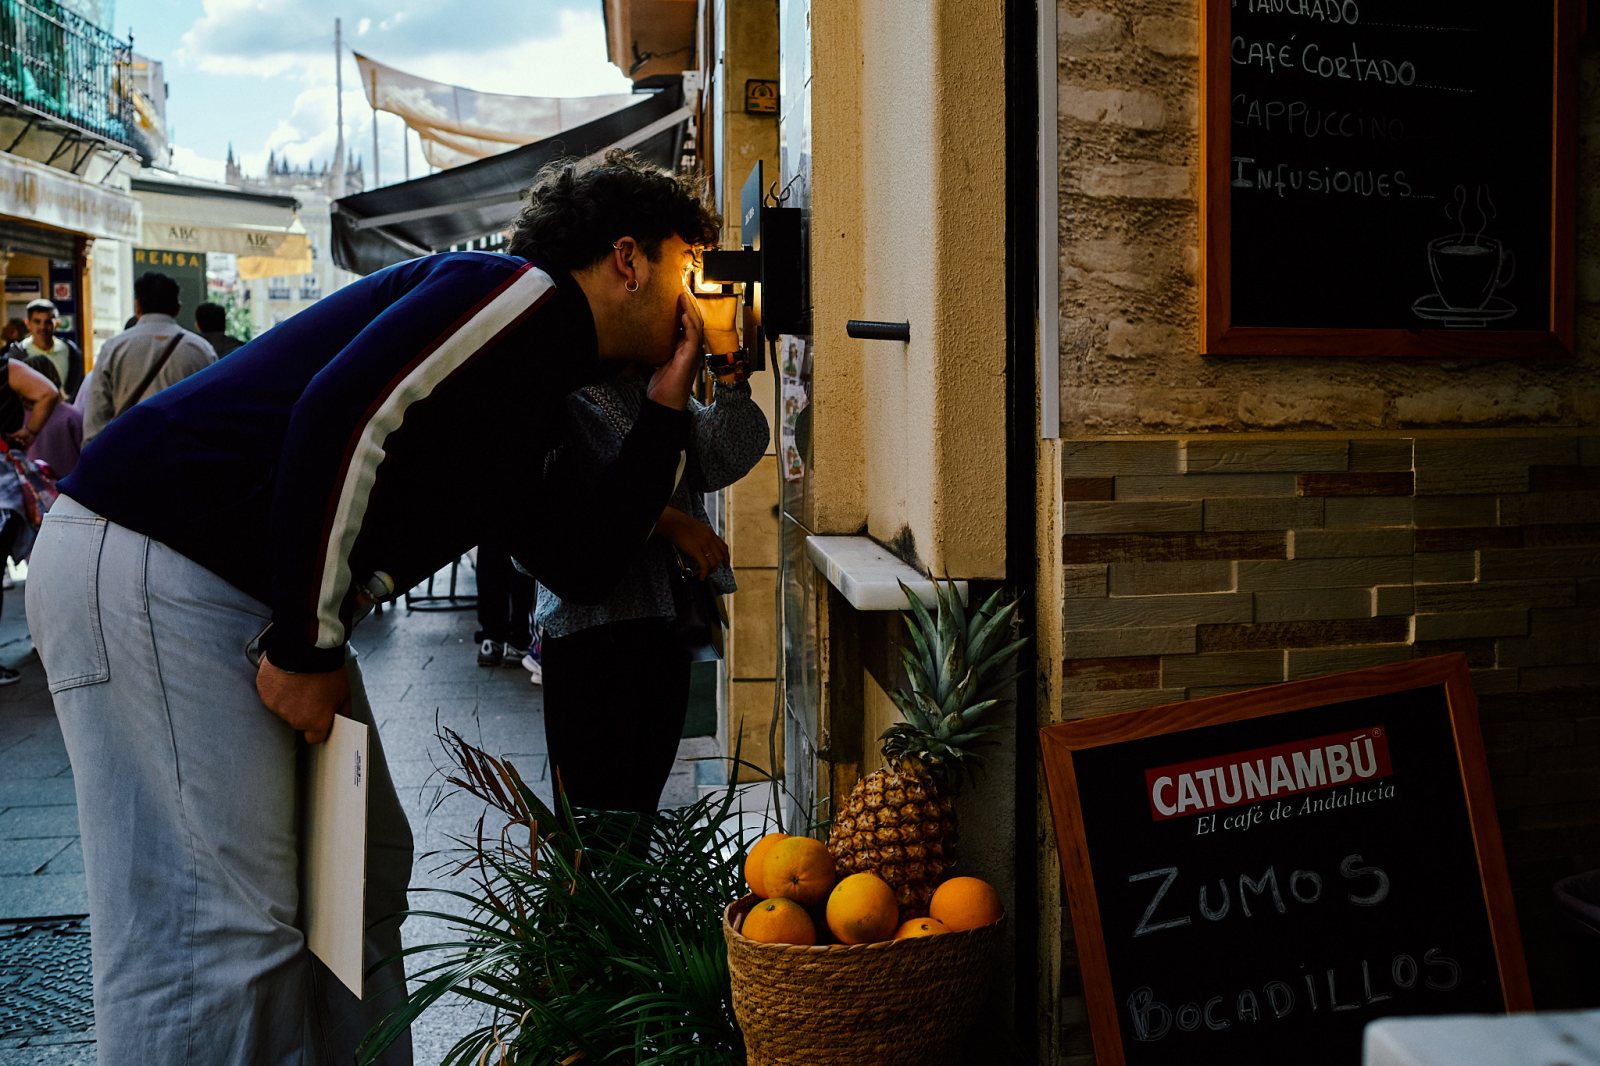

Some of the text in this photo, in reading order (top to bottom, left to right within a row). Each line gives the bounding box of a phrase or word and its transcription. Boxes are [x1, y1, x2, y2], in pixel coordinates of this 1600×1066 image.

[168, 226, 273, 247] ABC ABC
[1195, 781, 1396, 836] El café de Andalucía
